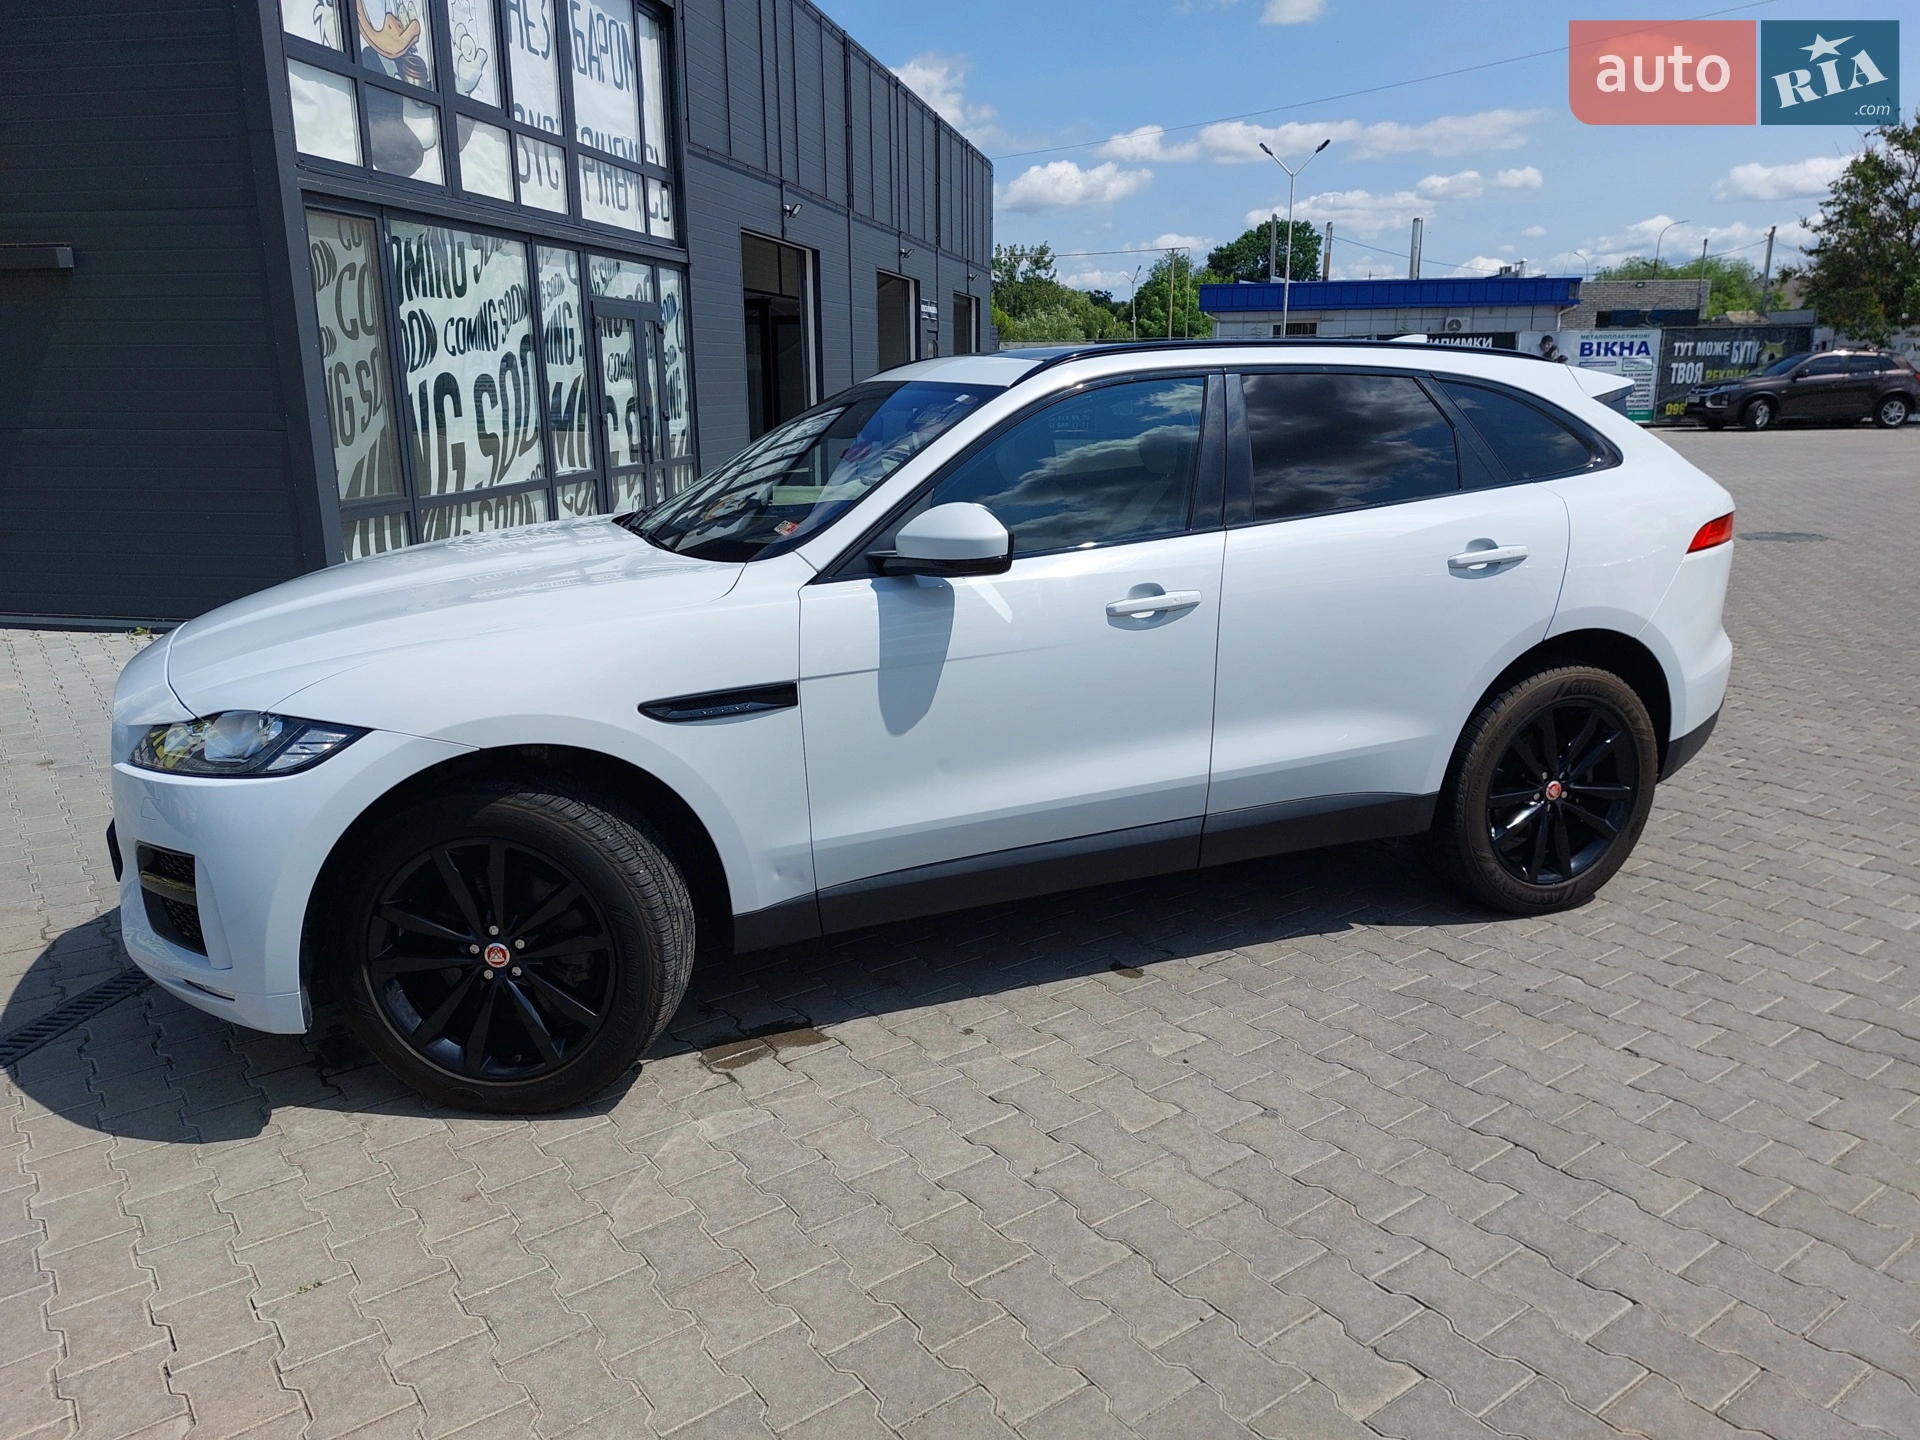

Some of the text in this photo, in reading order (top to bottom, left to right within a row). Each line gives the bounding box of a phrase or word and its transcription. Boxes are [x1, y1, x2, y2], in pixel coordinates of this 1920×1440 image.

[443, 298, 499, 357] COMING
[1579, 341, 1651, 357] ВІКНА
[1673, 340, 1760, 364] ТУТ МОЖЕ БУТИ
[1671, 362, 1704, 385] ТВОЯ
